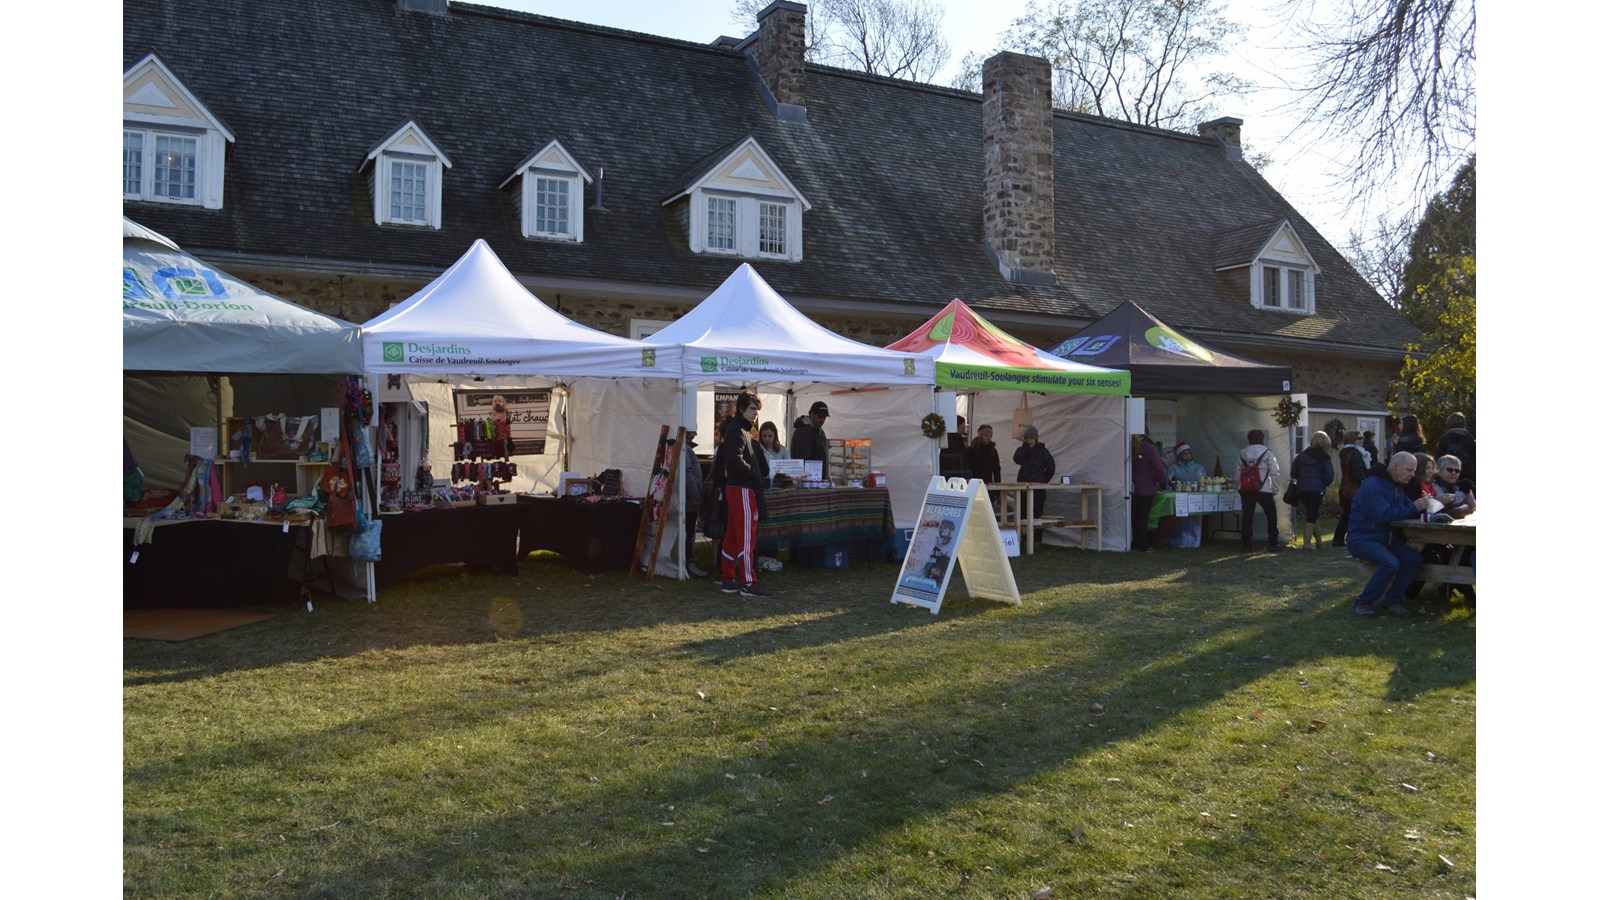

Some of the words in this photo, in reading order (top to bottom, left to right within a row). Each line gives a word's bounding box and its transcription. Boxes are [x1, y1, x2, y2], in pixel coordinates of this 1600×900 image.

[408, 342, 472, 356] Desjardins
[408, 355, 434, 364] Caisse
[435, 356, 446, 364] de
[446, 356, 520, 366] Vaudreuil-Soulanges
[720, 356, 769, 367] Desjardins
[950, 368, 1030, 384] Vaudreuil-Soulanges
[1031, 373, 1067, 385] stimulate
[1067, 377, 1085, 387] your
[1085, 376, 1096, 386] six
[1097, 378, 1122, 388] senses!
[925, 507, 962, 518] ALFAJORES
